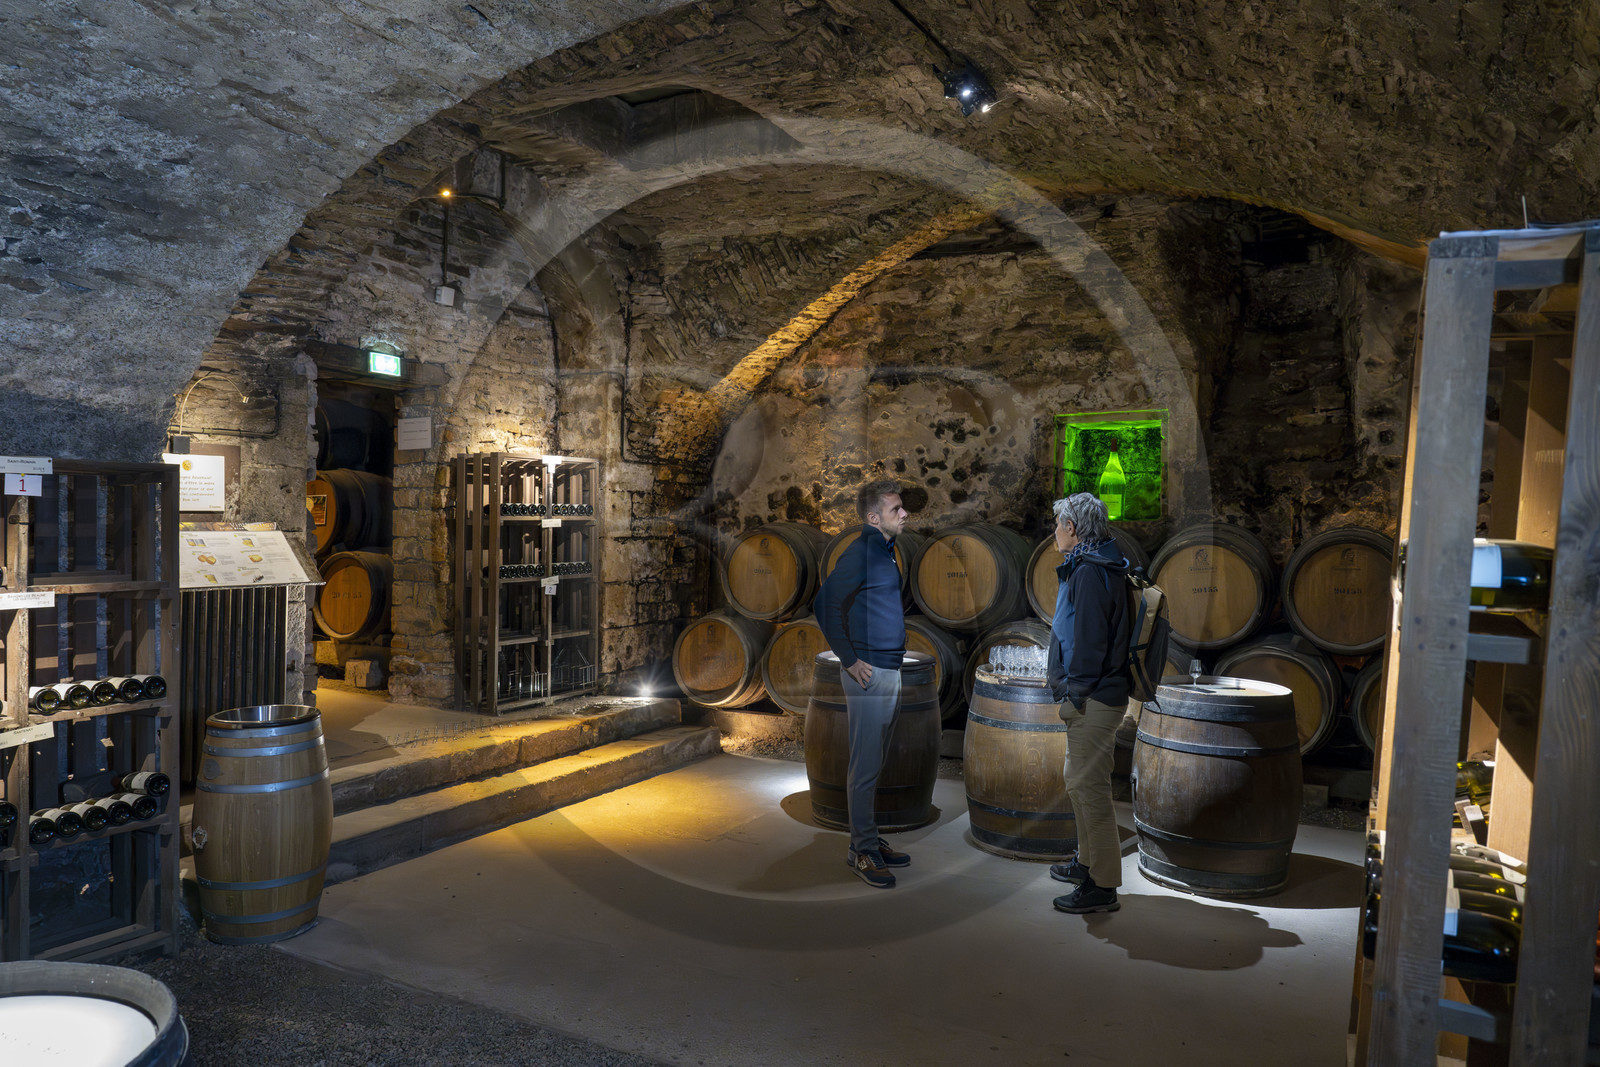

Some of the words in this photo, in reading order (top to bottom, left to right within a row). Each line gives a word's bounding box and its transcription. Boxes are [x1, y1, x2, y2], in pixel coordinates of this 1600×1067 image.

[19, 479, 27, 492] 1
[548, 586, 553, 594] 2
[1192, 586, 1219, 594] 20155
